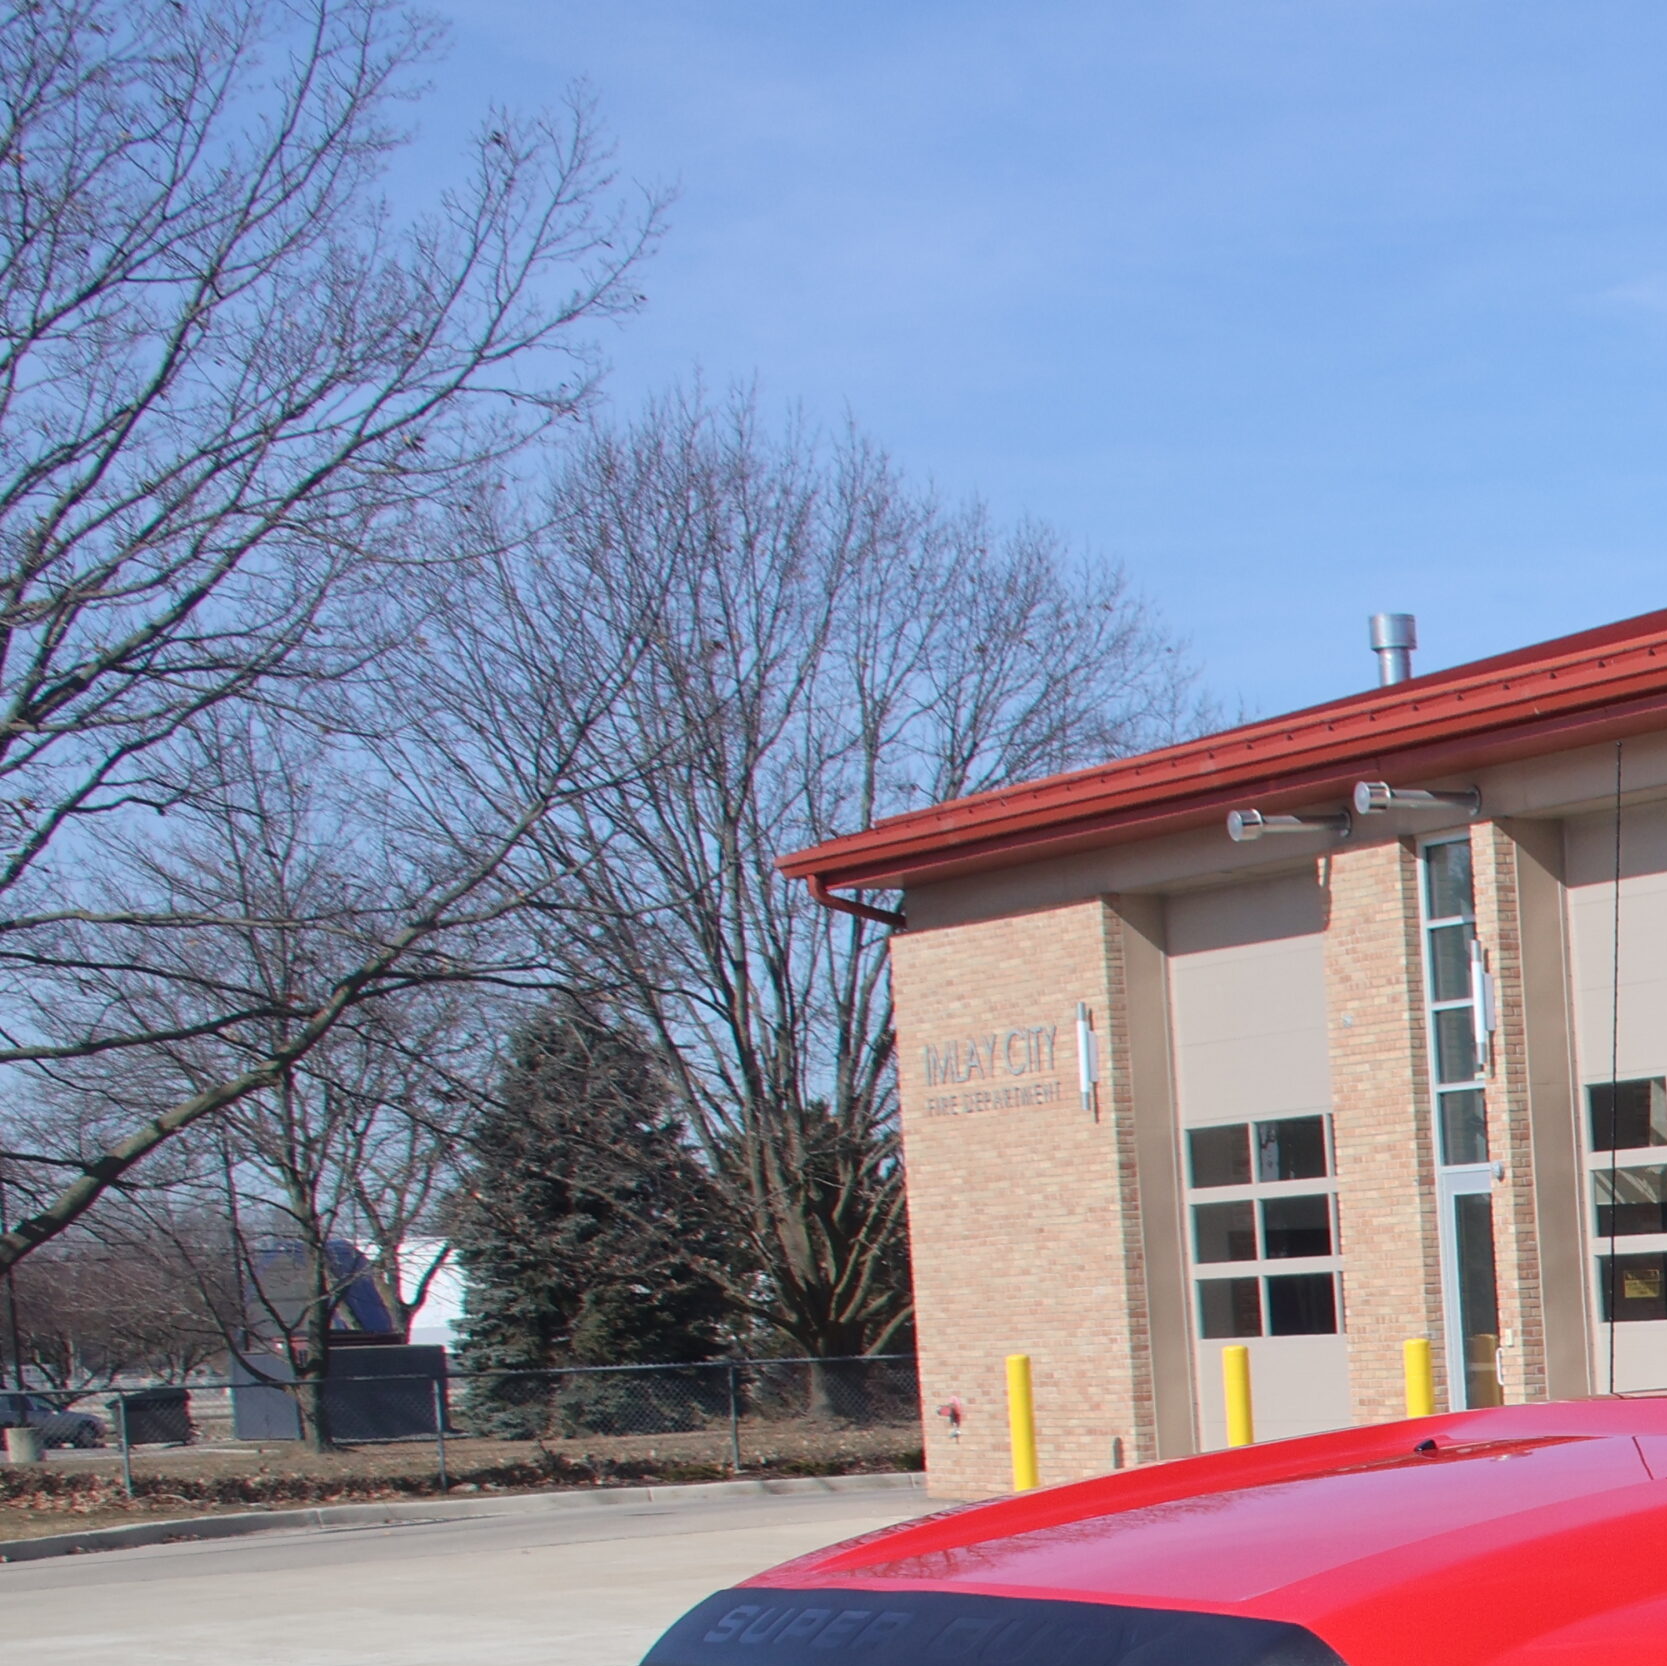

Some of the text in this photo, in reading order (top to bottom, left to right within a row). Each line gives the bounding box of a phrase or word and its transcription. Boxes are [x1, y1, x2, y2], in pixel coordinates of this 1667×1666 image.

[925, 1025, 1057, 1087] IMLAY CITY
[928, 1081, 1062, 1118] FIRE DEPARTMENT
[702, 1605, 916, 1649] SUPER
